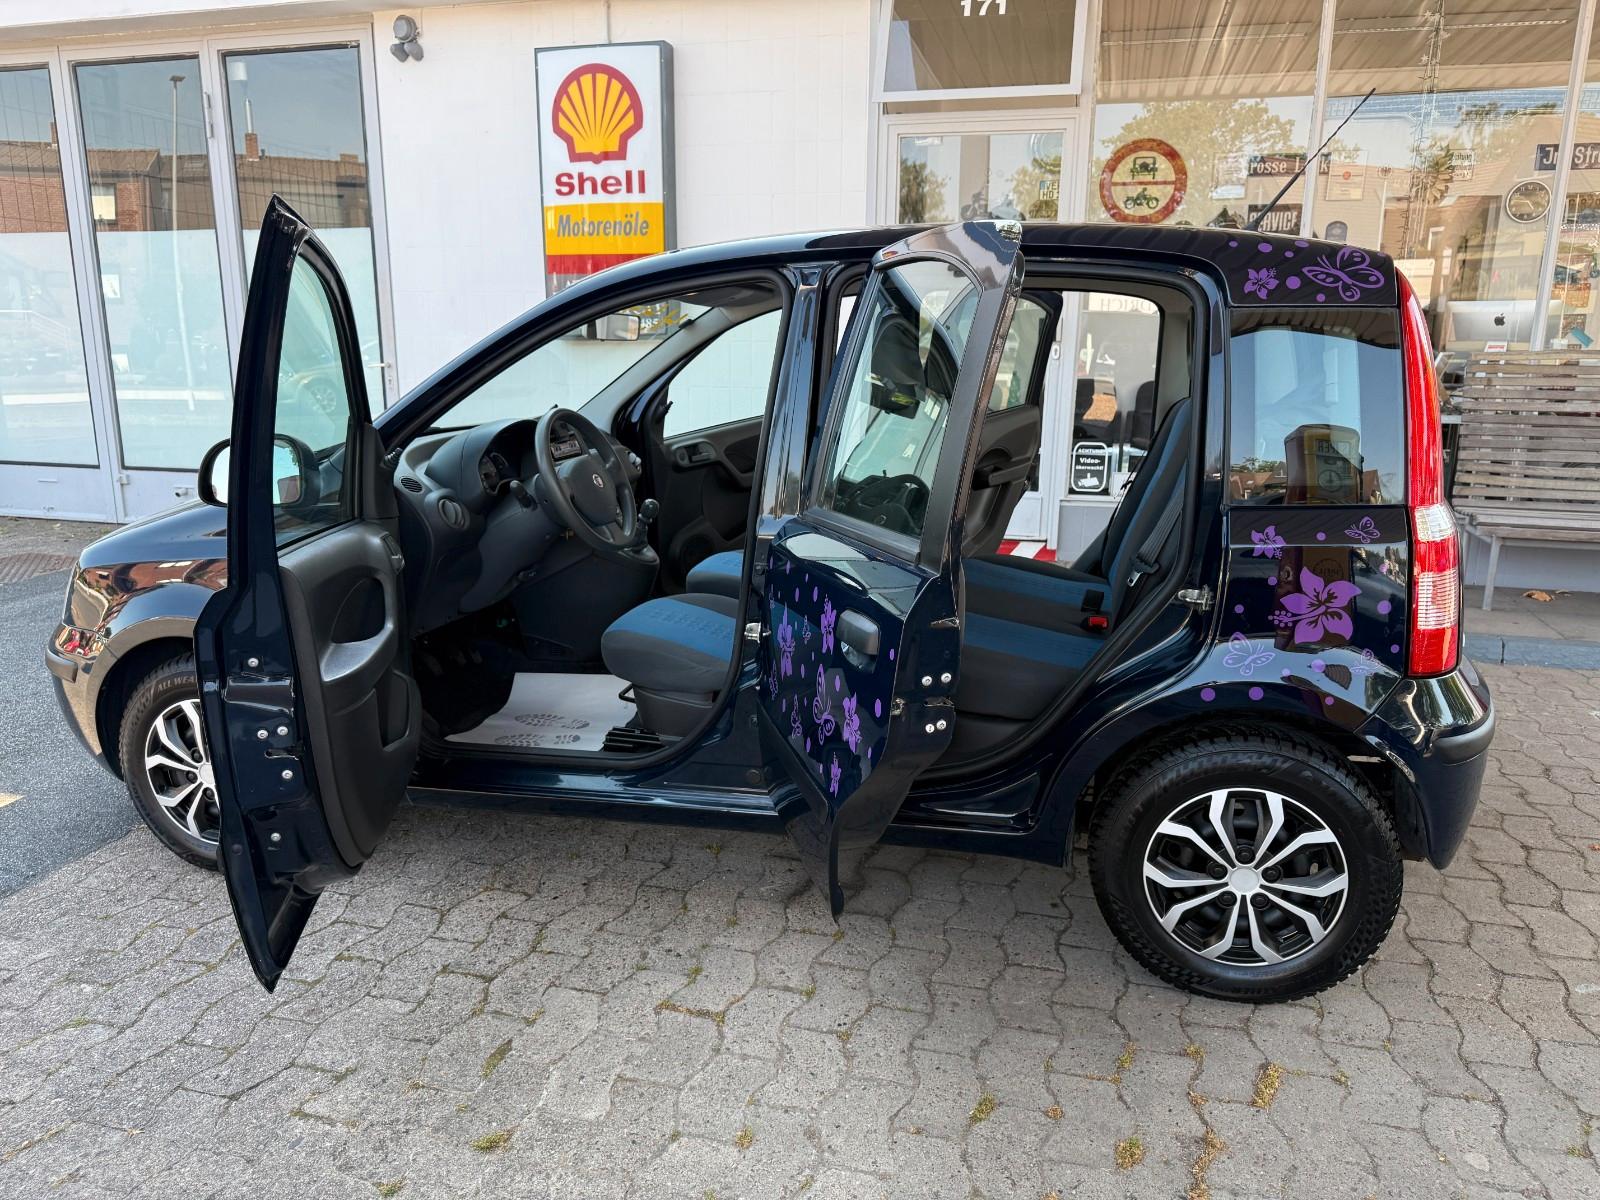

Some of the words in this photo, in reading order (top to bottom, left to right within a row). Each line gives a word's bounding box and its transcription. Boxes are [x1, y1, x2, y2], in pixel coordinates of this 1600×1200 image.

[961, 0, 1007, 17] 171
[555, 170, 646, 196] Shell
[557, 211, 650, 238] Motorenöle
